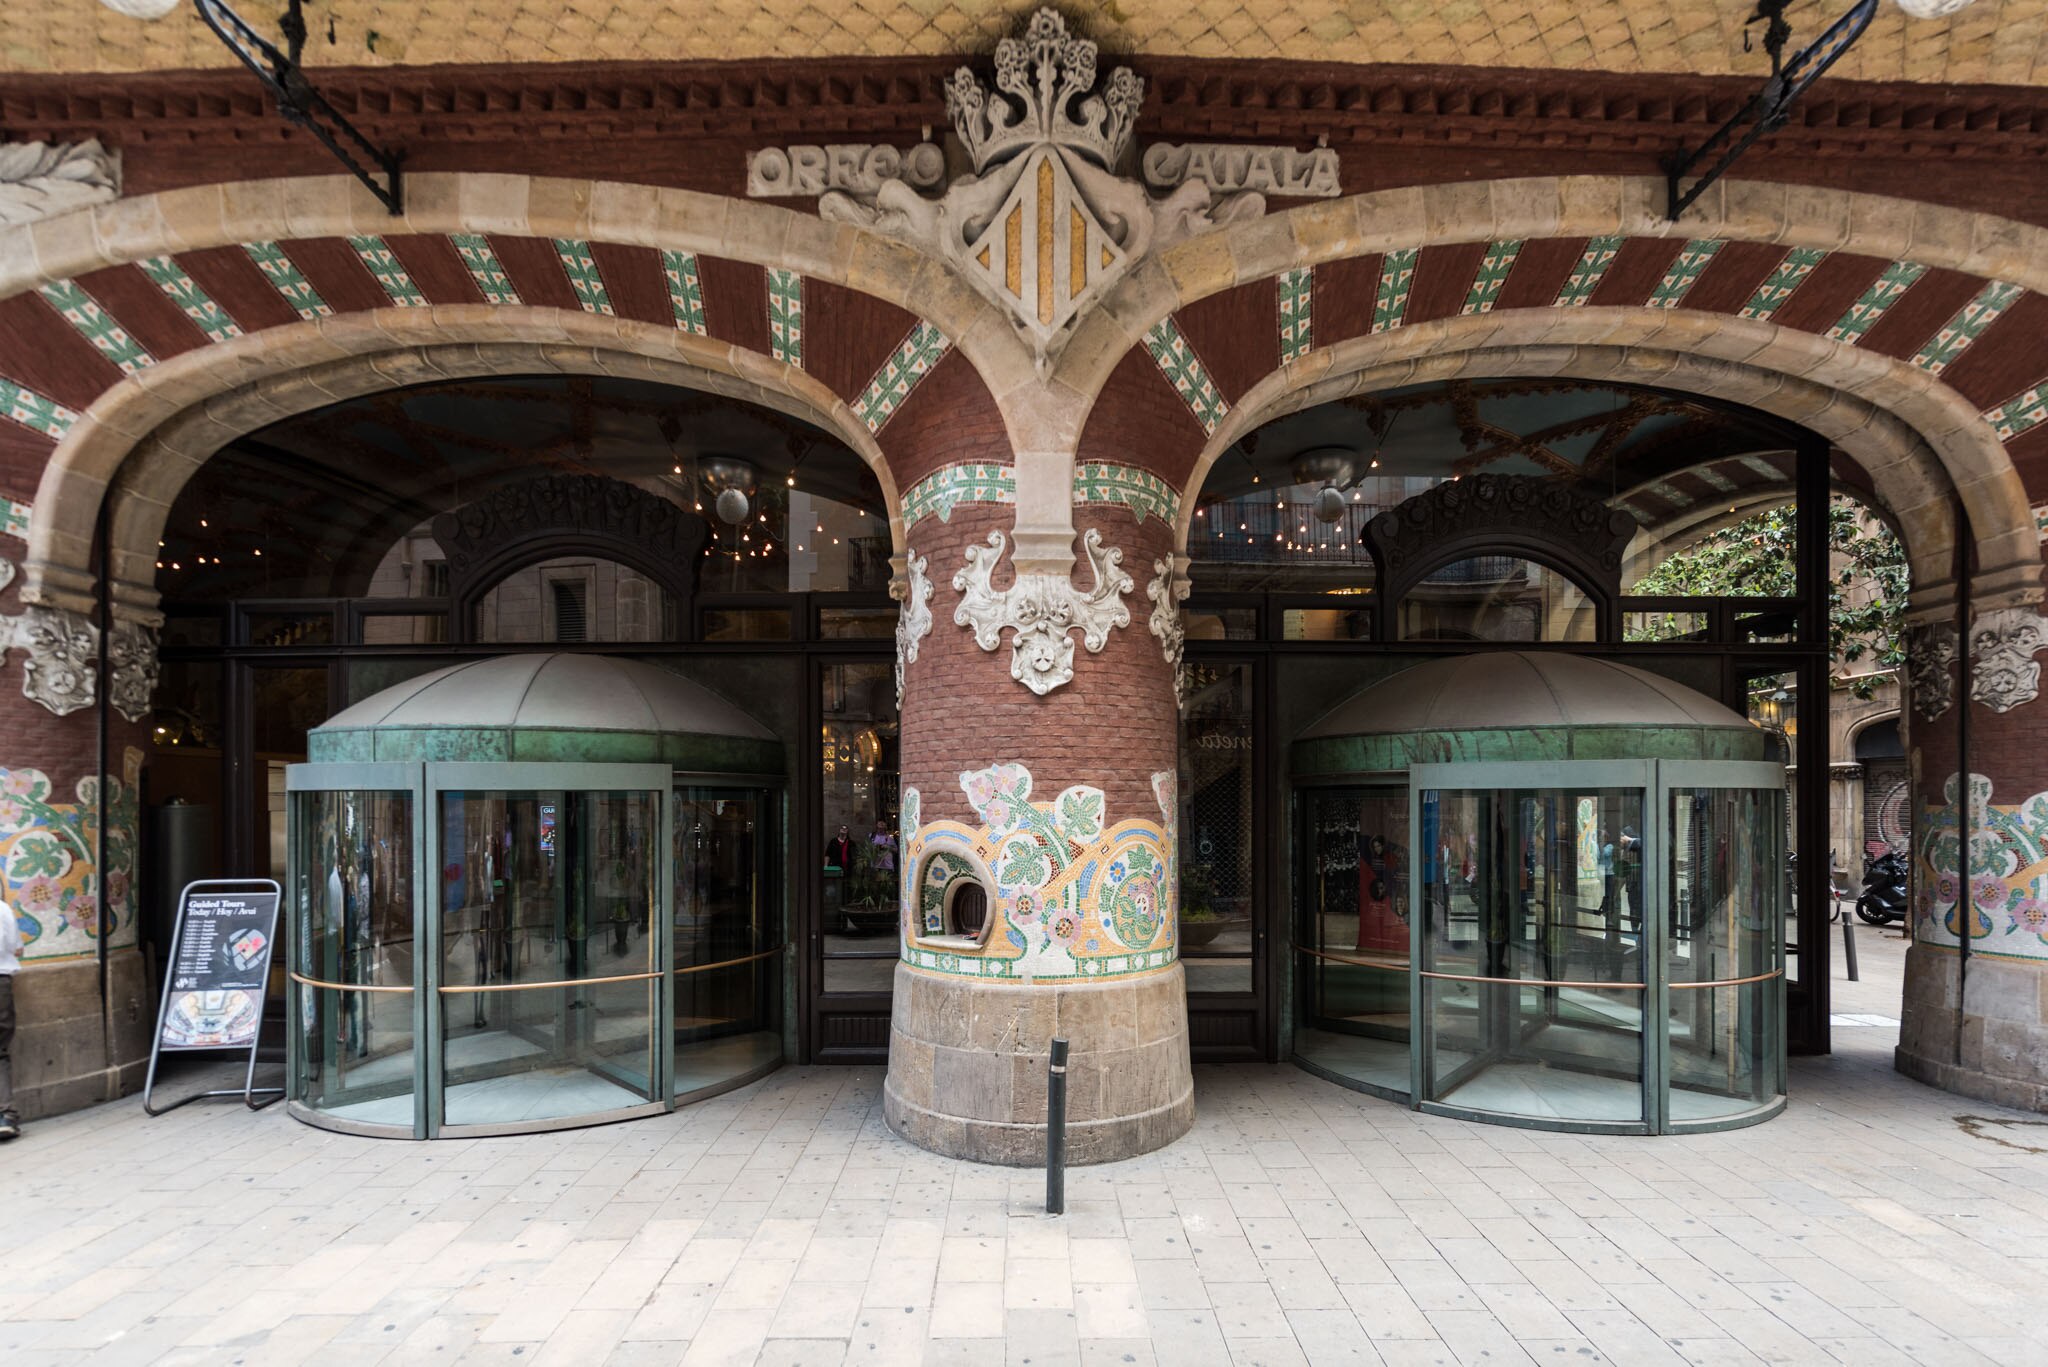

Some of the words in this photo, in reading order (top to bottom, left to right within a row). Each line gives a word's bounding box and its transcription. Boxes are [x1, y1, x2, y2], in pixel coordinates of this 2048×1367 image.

[188, 900, 220, 908] Guided
[221, 900, 246, 908] Tours
[187, 907, 211, 917] Today
[216, 907, 233, 917] Hoy
